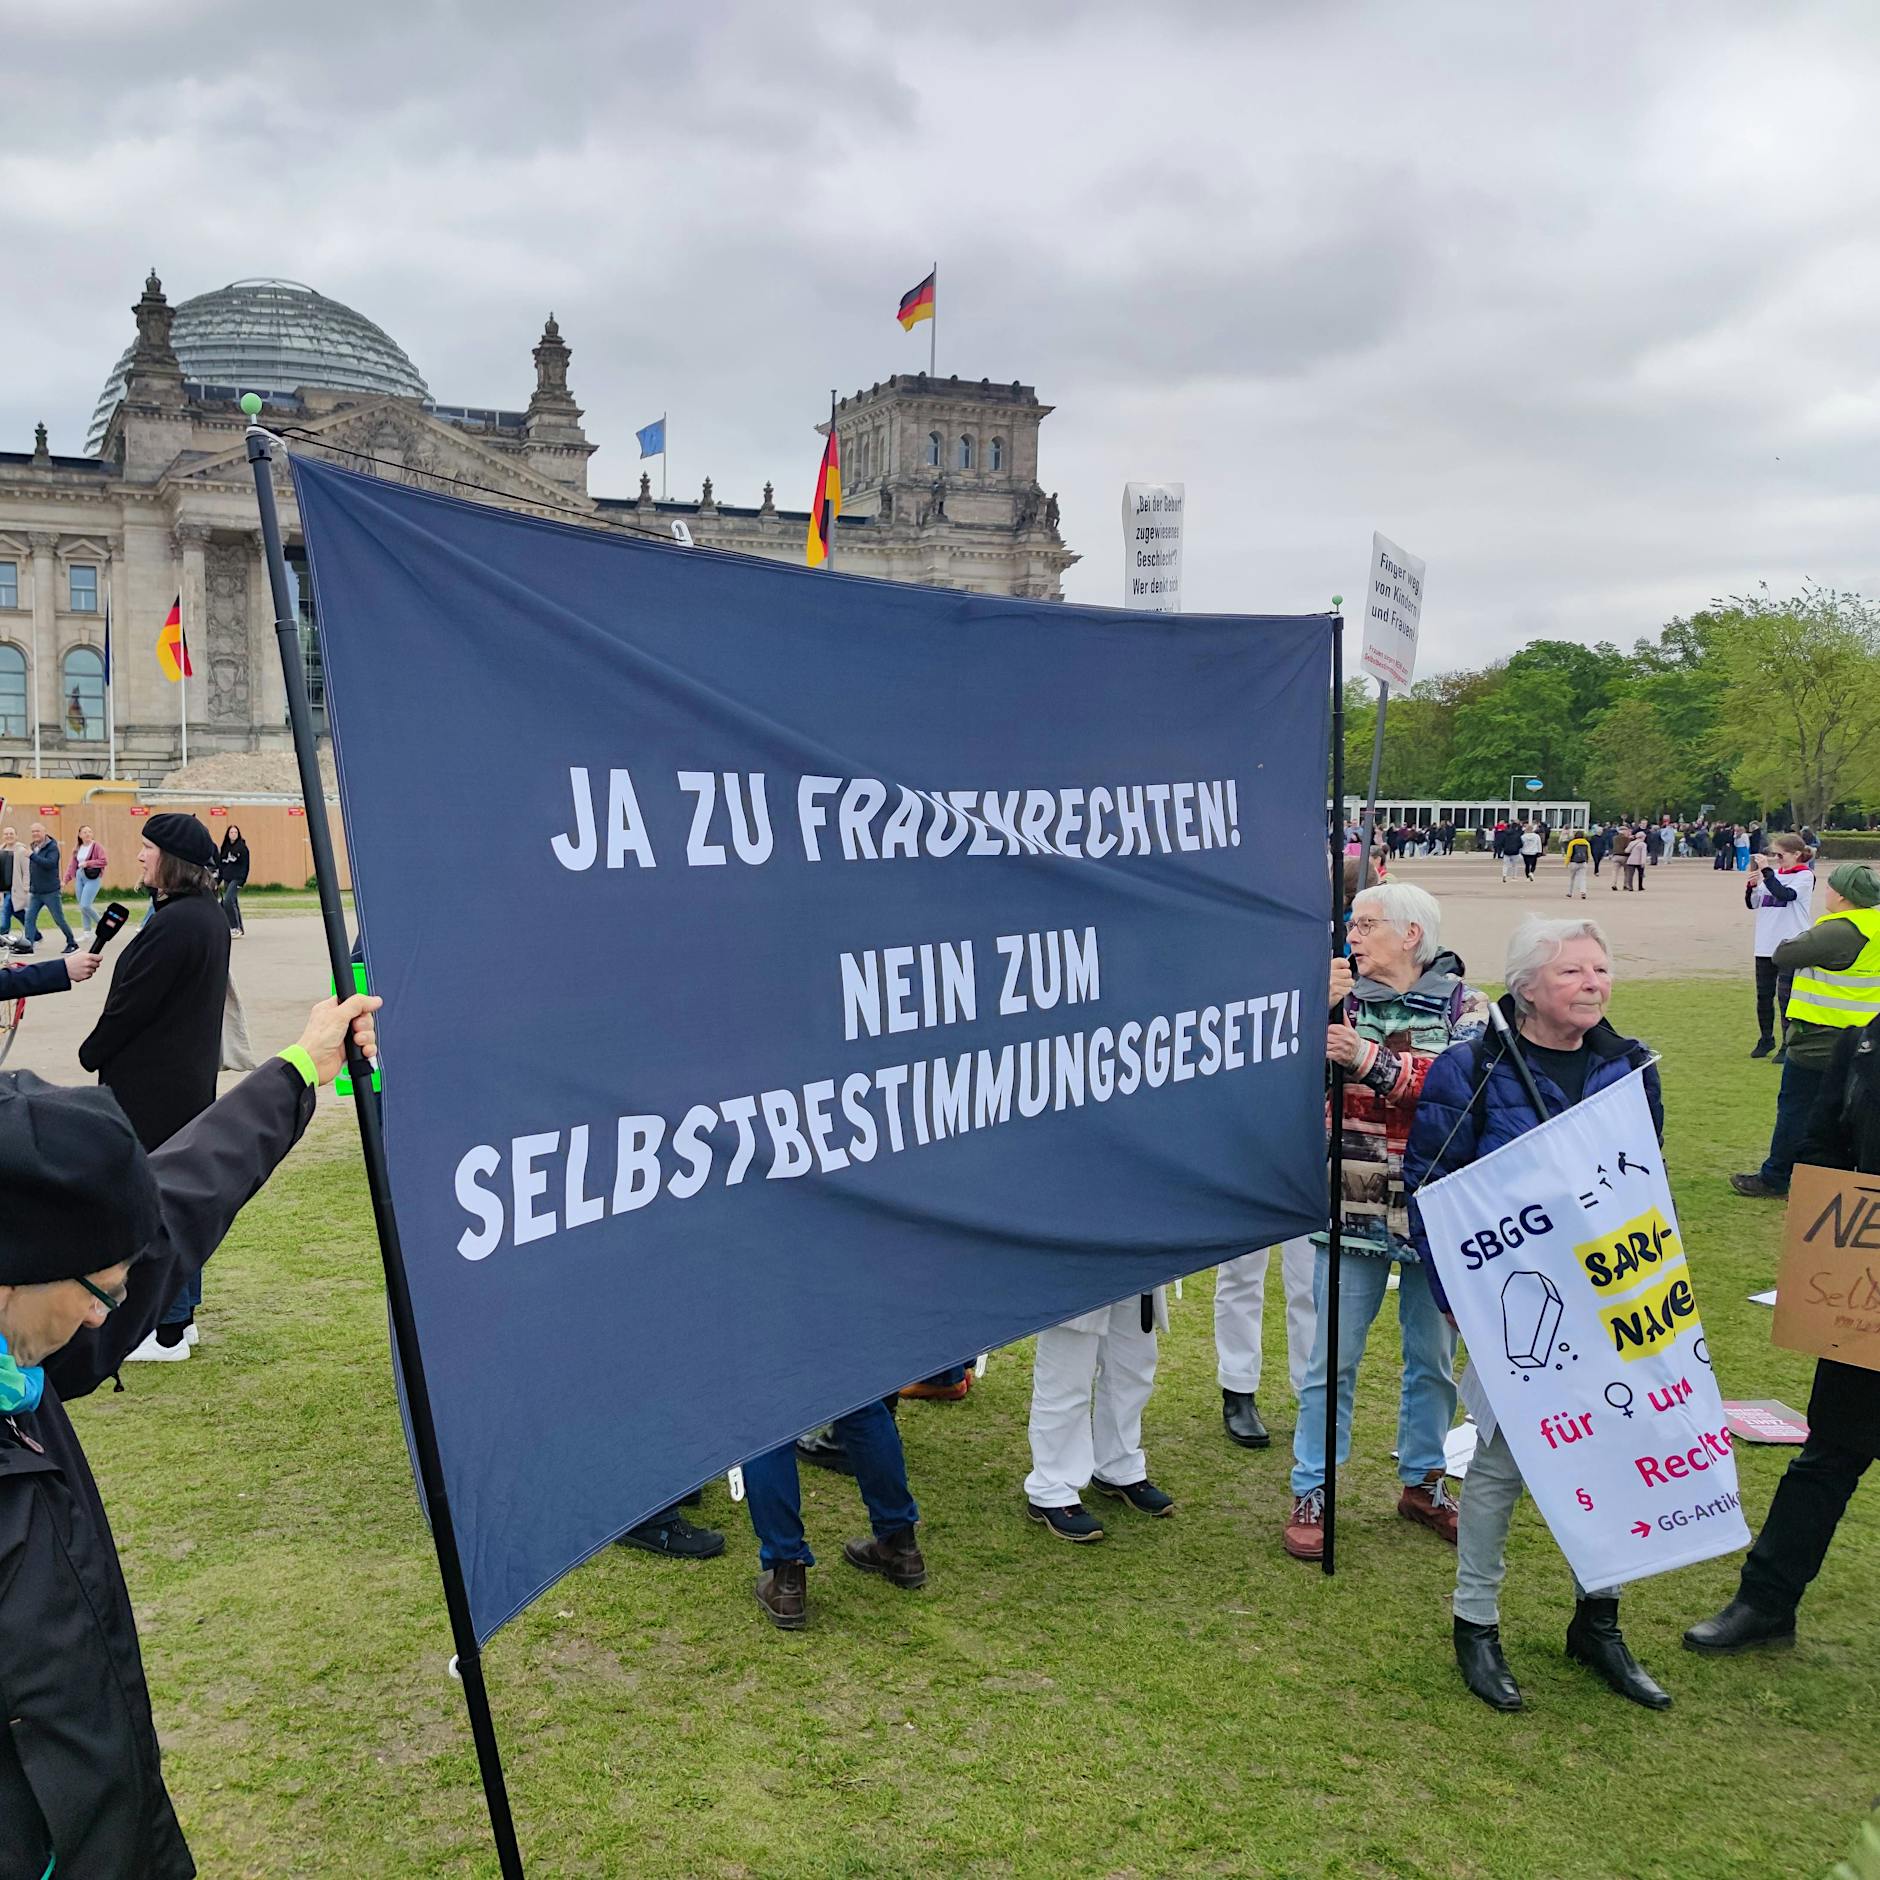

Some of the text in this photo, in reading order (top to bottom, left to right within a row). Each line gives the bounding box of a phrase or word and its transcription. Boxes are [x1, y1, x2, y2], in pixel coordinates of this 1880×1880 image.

[1153, 495, 1163, 512] der
[1164, 495, 1182, 512] Geburt
[1136, 526, 1179, 544] zugewiesenes
[1132, 577, 1148, 595] Wer
[1151, 577, 1168, 594] denkt
[1380, 552, 1420, 596] Finger weg
[1375, 580, 1418, 618] von Kindern
[1371, 604, 1416, 642] und Frauen!
[551, 767, 1241, 870] JA ZU FRAUENRECHTEN!
[841, 927, 1100, 1040] NEIN ZUM
[455, 990, 1300, 1261] SELBSTBESTIMMUNGSGESETZ!
[1460, 1204, 1554, 1270] SBGG
[1540, 1412, 1593, 1449] für
[1575, 1488, 1594, 1511] §
